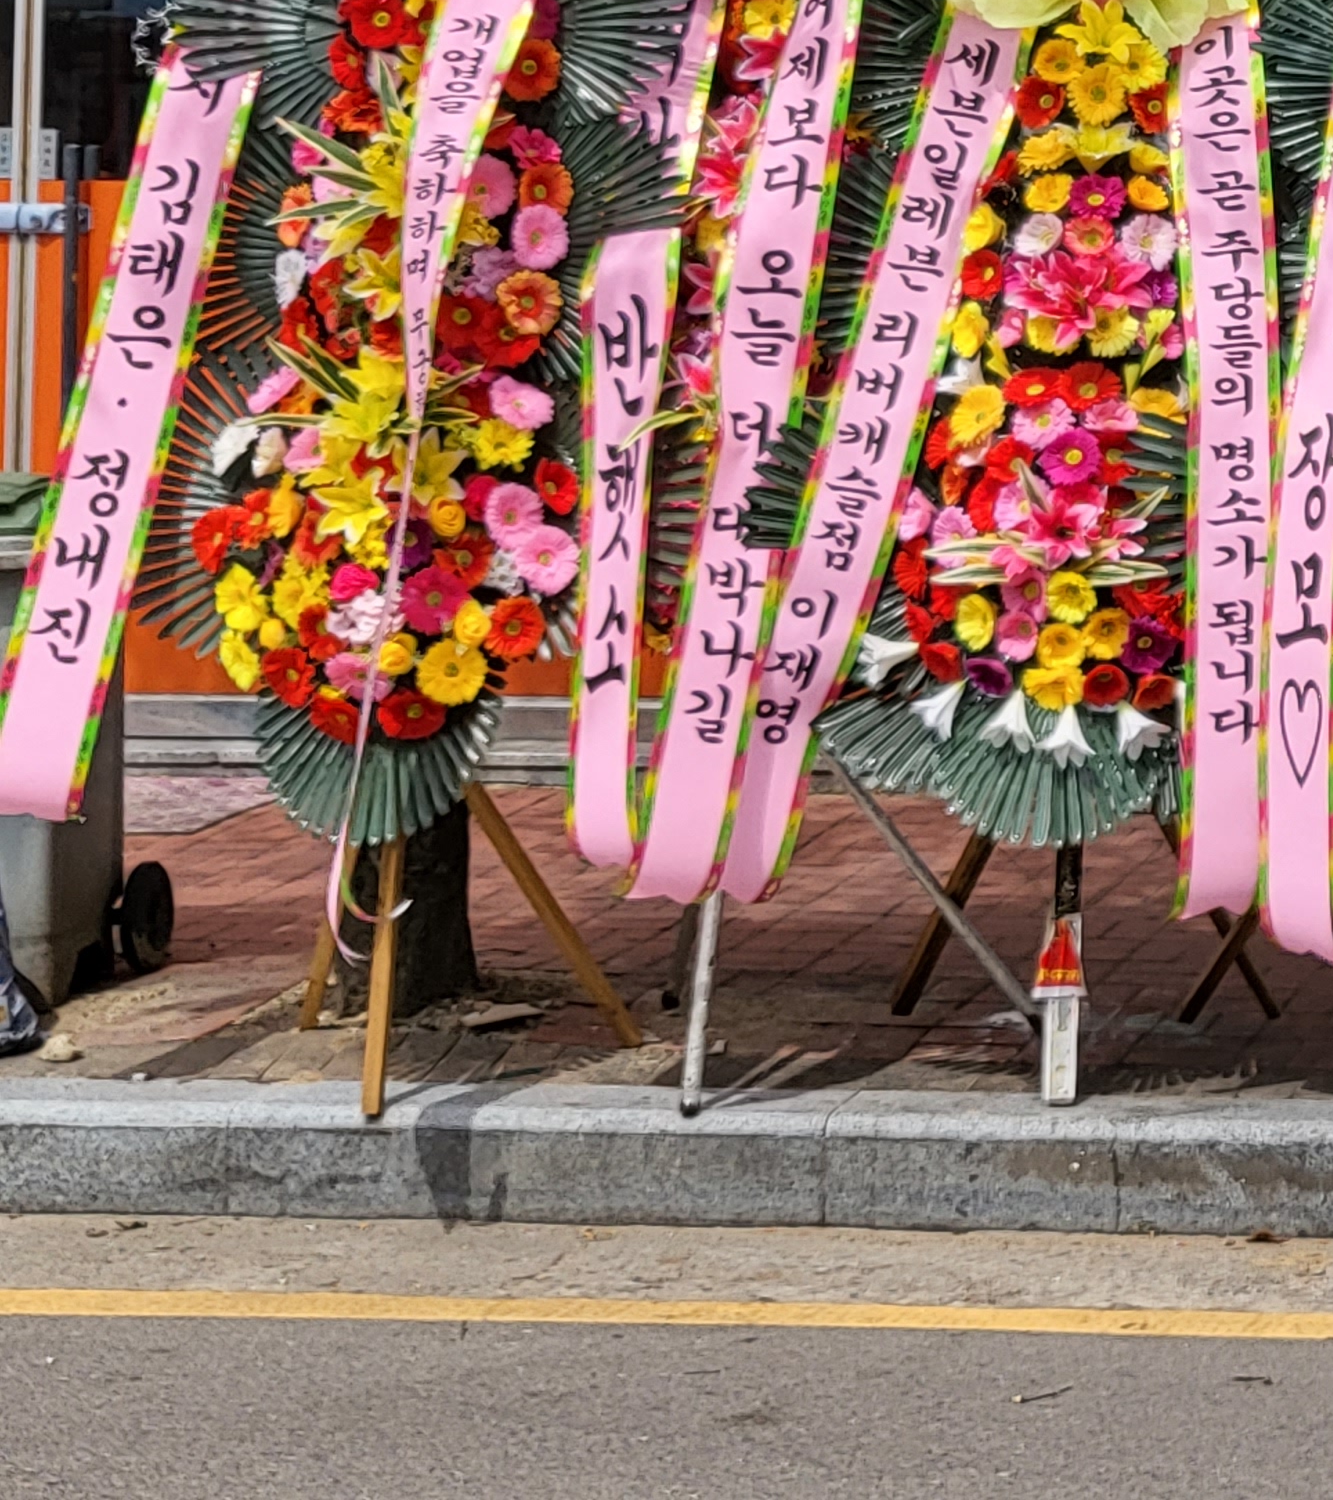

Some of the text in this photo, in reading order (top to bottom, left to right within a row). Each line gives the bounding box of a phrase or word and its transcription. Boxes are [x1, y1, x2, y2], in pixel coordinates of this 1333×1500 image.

[430, 14, 499, 113] 개업을
[108, 159, 200, 370] 김태은
[406, 135, 466, 282] 축하하며
[731, 250, 802, 366] 오늘
[730, 402, 772, 458] 더
[755, 39, 1000, 745] 세븐일레븐 리버캐슬점 이재영
[1190, 26, 1269, 745] 이곳은 곧 주당들의 명소가 됩니다
